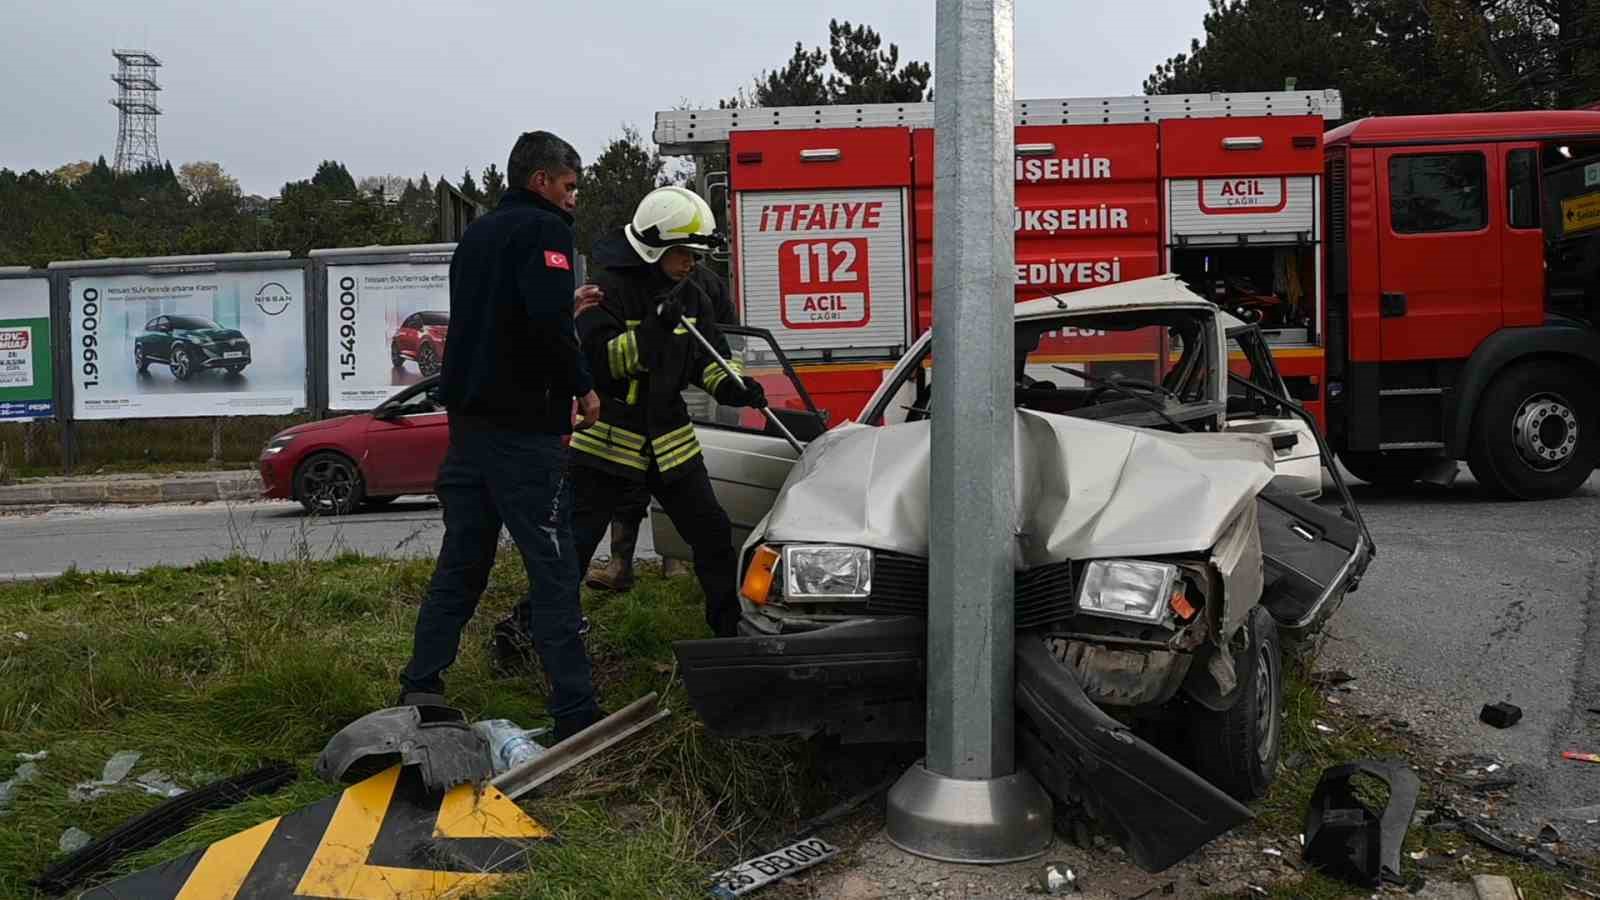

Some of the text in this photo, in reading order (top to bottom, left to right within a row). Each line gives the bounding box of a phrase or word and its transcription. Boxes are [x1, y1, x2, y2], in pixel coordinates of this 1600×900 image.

[760, 201, 883, 232] İTFAİYE
[792, 241, 858, 283] 112
[254, 295, 292, 303] NISSAN
[82, 287, 99, 390] 1.999.000
[340, 276, 356, 380] 1.549.000
